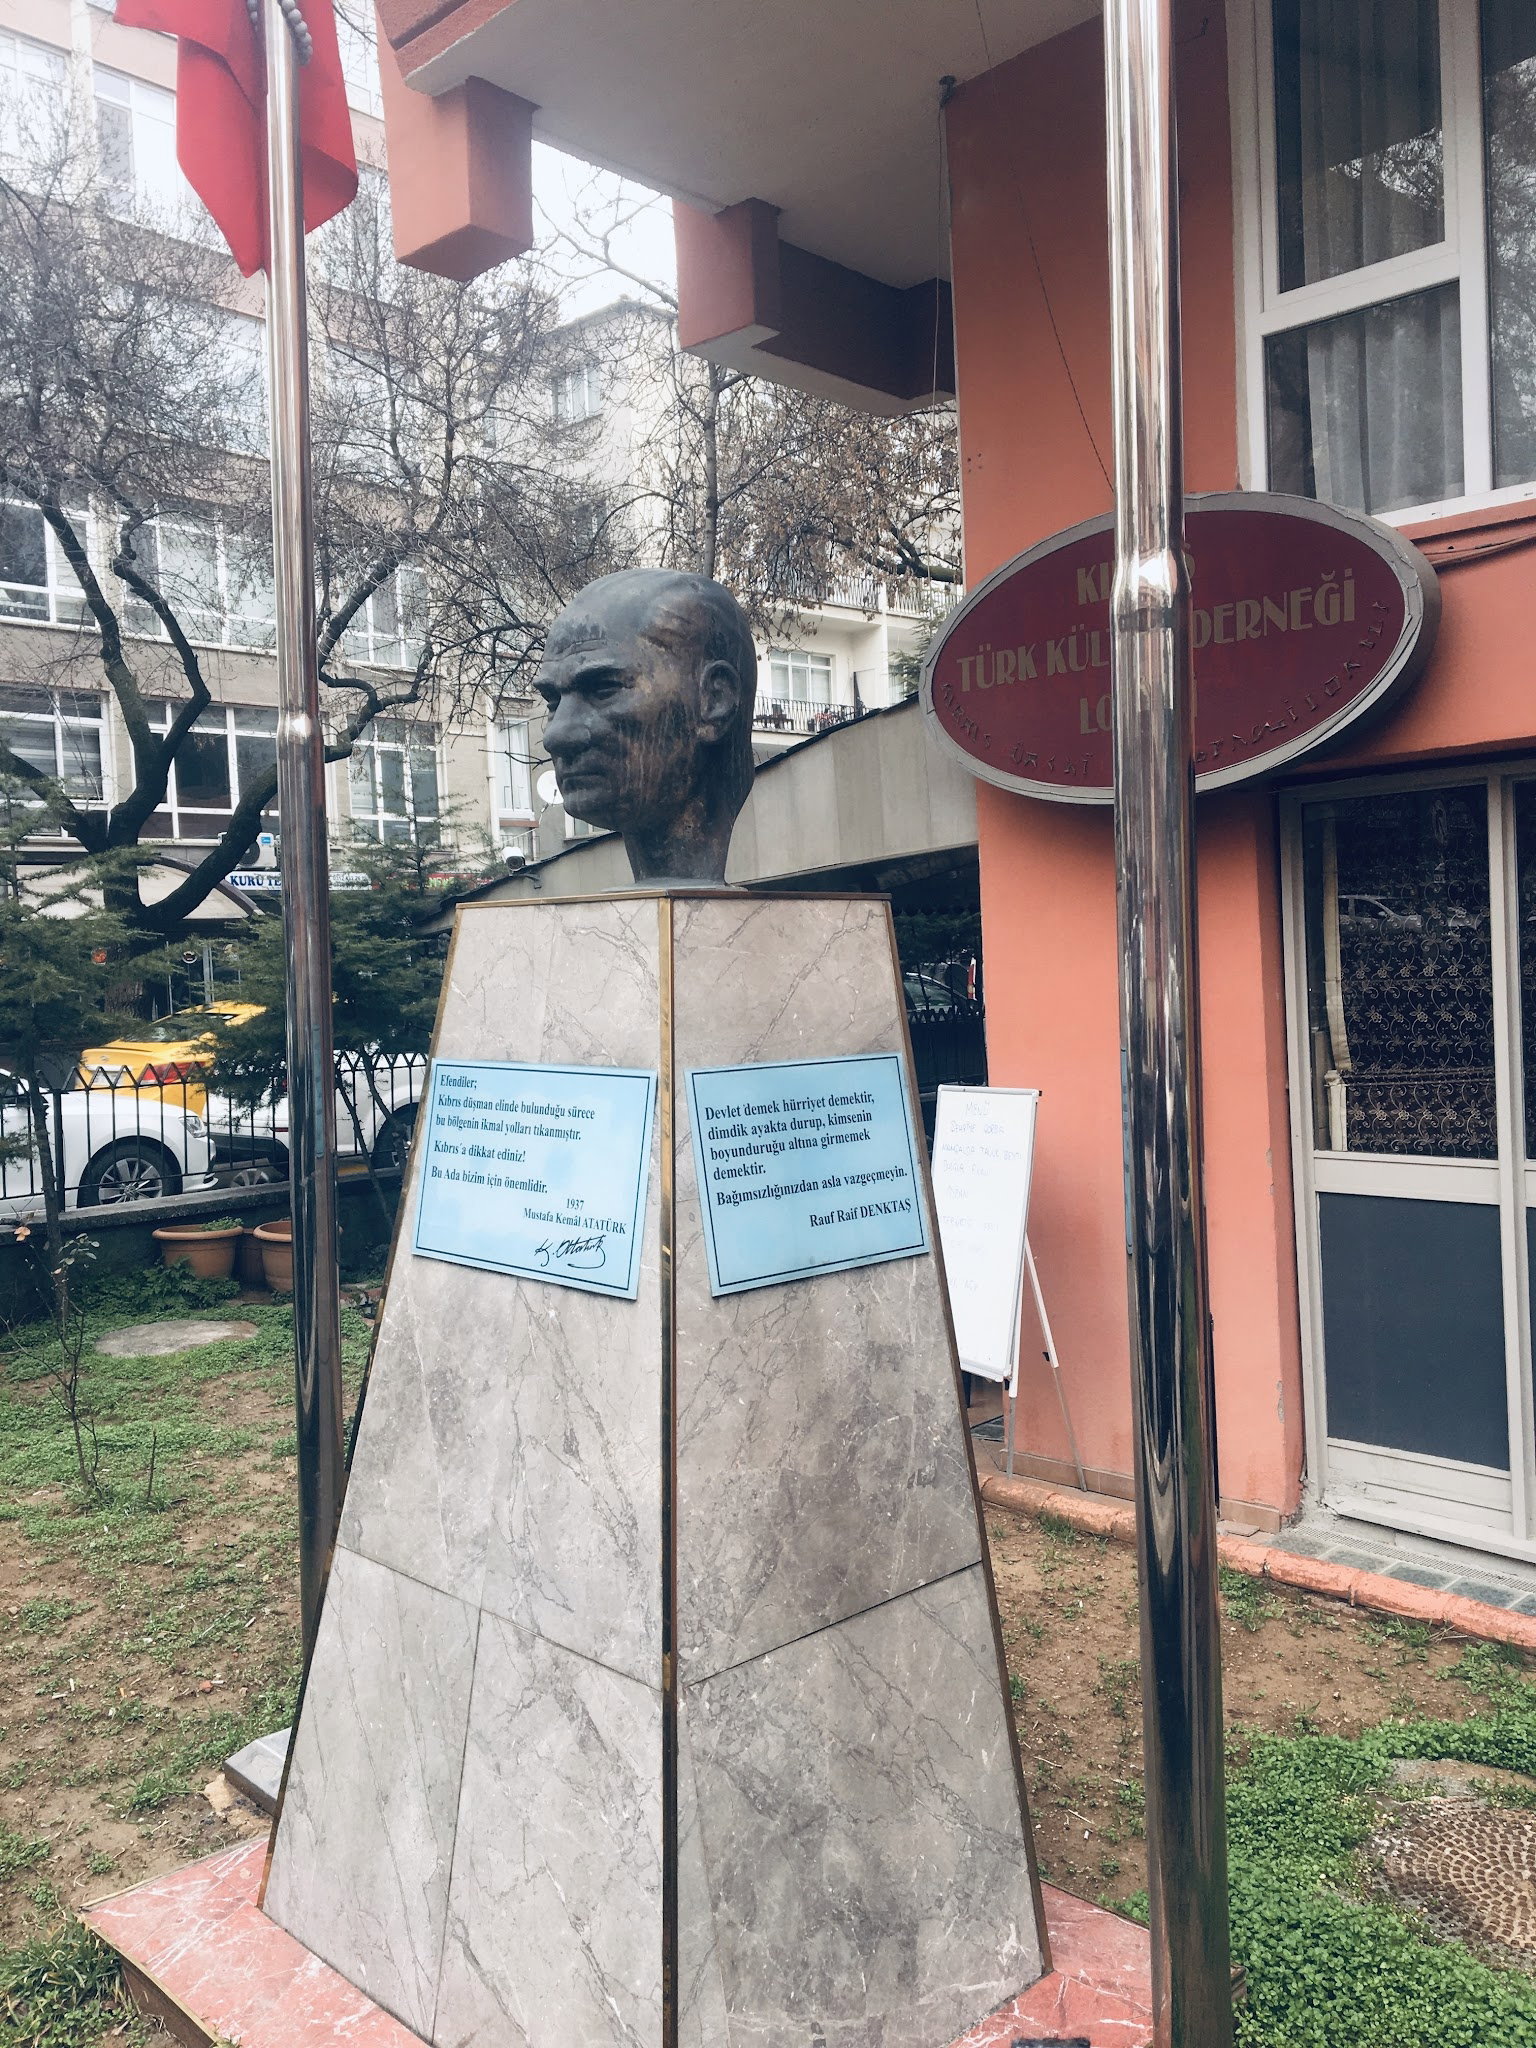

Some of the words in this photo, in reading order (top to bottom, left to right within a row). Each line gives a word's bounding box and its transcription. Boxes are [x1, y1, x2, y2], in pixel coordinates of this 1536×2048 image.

[957, 643, 1037, 692] TÜRK
[1046, 623, 1110, 676] KÜL
[1192, 568, 1356, 649] DERNEĞİ
[230, 875, 264, 887] KURU
[440, 1075, 477, 1090] Efendiler;
[438, 1094, 461, 1107] Kıbrıs
[463, 1097, 493, 1115] düşman
[495, 1100, 518, 1112] elinde
[521, 1100, 565, 1119] bulunduğu
[568, 1107, 594, 1119] sürece
[705, 1106, 741, 1120] Devlet
[744, 1101, 780, 1115] demek
[783, 1097, 825, 1114] hürriyet
[828, 1091, 875, 1107] demektir,
[436, 1114, 446, 1125] bu
[448, 1116, 478, 1131] bölgenin
[481, 1118, 503, 1131] ikmal
[505, 1121, 531, 1136] yolları
[533, 1124, 581, 1141] tıkanmıştır.
[708, 1125, 748, 1140] dimdik
[751, 1119, 787, 1137] ayakta
[790, 1117, 825, 1133] durup,
[828, 1110, 872, 1126] kimsenin
[468, 1144, 495, 1158] dikkat
[497, 1148, 525, 1162] ediniz!
[711, 1140, 785, 1162] boyunduruğu
[788, 1138, 818, 1150] altına
[821, 1129, 870, 1149] girmemek
[432, 1166, 442, 1178] Bu
[444, 1169, 460, 1180] Ada
[462, 1171, 484, 1184] bizim
[487, 1175, 502, 1188] için
[505, 1177, 547, 1193] önemlidir.
[713, 1163, 766, 1180] demektir.
[717, 1180, 819, 1206] Bağımsızlığınızdan
[822, 1173, 841, 1188] asla
[843, 1166, 908, 1185] vazgeçmeyin.
[567, 1198, 584, 1210] 1937
[809, 1211, 834, 1227] Rauf
[836, 1207, 859, 1222] Raif
[860, 1199, 912, 1218] DENKTAŞ
[524, 1208, 554, 1221] Mustafa
[582, 1218, 625, 1234] ATATÜRK
